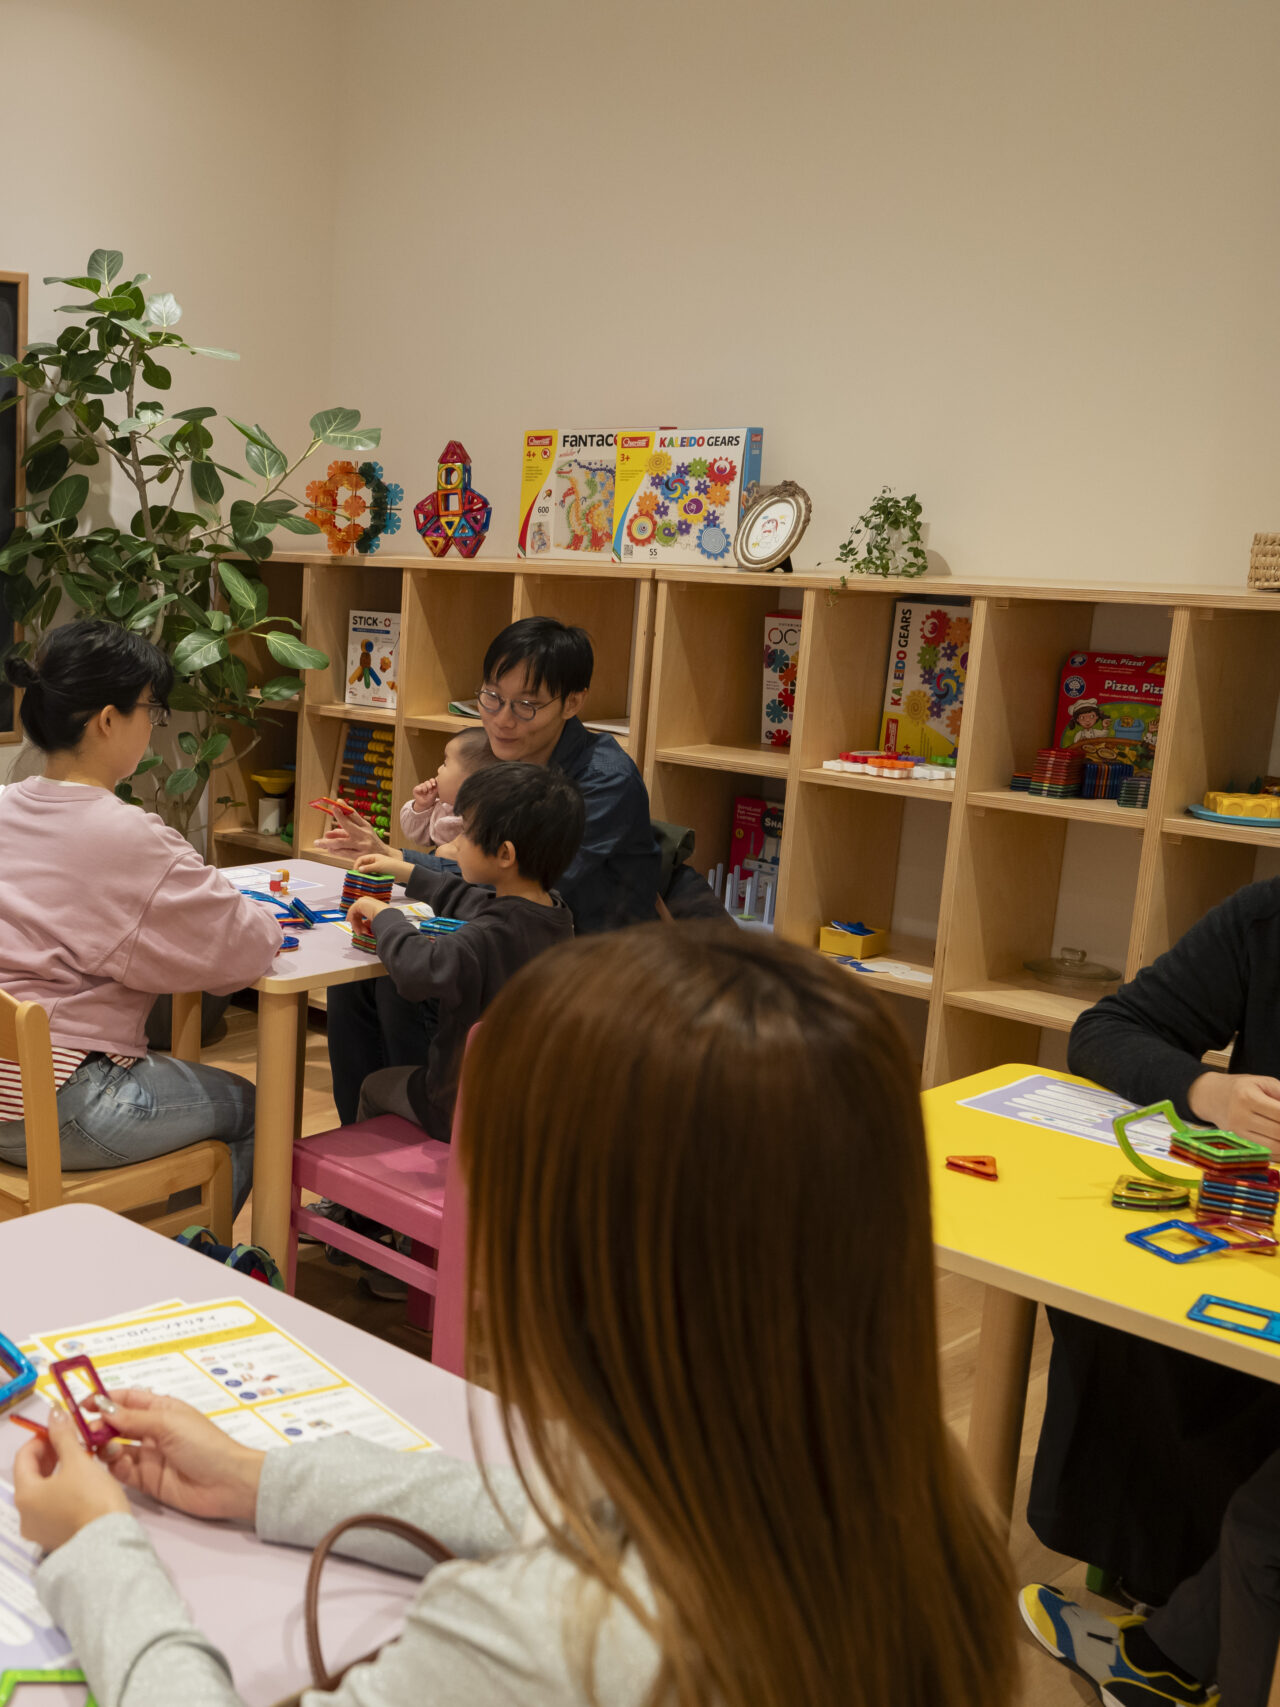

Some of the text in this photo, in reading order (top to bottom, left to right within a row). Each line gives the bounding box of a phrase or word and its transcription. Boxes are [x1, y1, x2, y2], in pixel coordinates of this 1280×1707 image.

[659, 436, 705, 448] KALEIDO
[707, 435, 740, 447] GEARS
[537, 506, 550, 514] 600
[649, 548, 658, 556] 55
[898, 608, 912, 648] GEARS
[768, 627, 801, 646] OC
[890, 650, 907, 707] KALEIDO
[1104, 680, 1138, 694] Pizza,
